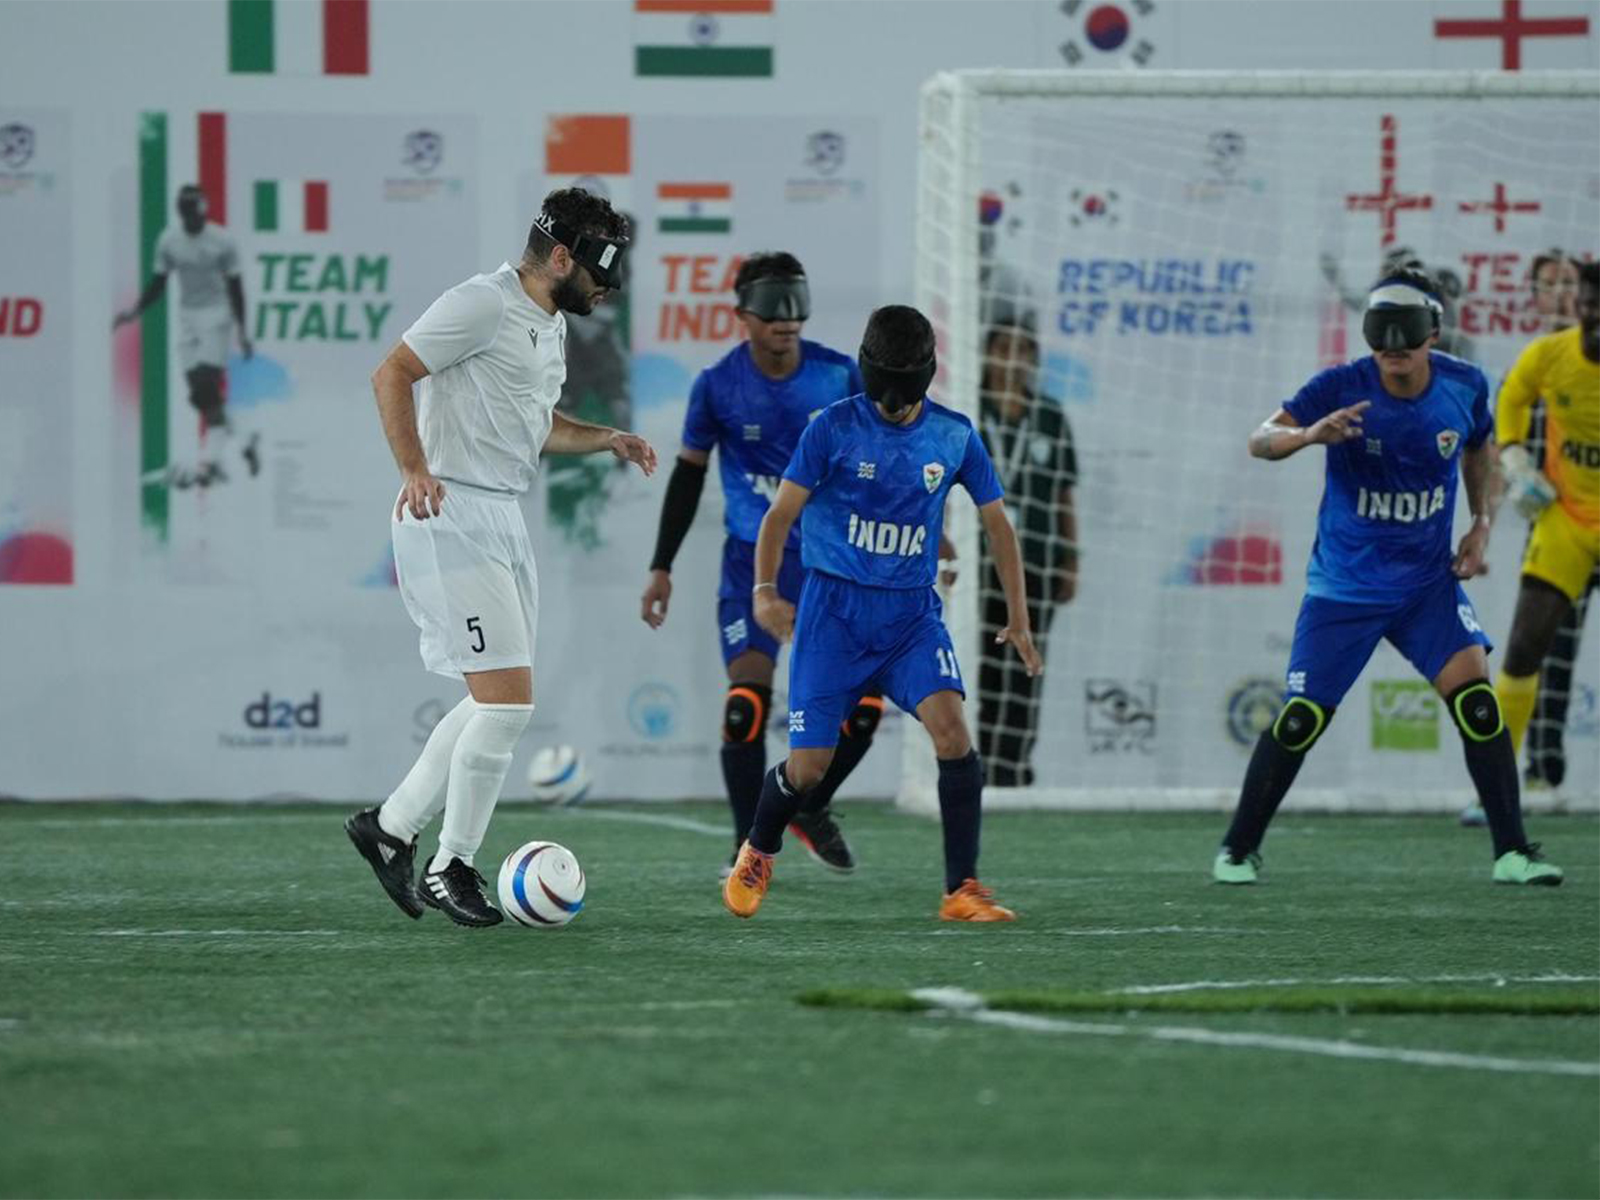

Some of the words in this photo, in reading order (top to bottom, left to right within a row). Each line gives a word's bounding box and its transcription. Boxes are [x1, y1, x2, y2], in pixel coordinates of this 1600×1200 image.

[257, 253, 390, 293] TEAM
[1057, 258, 1255, 294] REPUBLIC
[256, 302, 391, 341] ITALY
[1059, 300, 1109, 335] OF
[1119, 300, 1253, 335] KOREA
[1357, 485, 1445, 523] INDIA
[848, 513, 926, 557] INDIA
[466, 616, 485, 654] 5
[936, 647, 968, 679] 11
[243, 690, 321, 728] d2d
